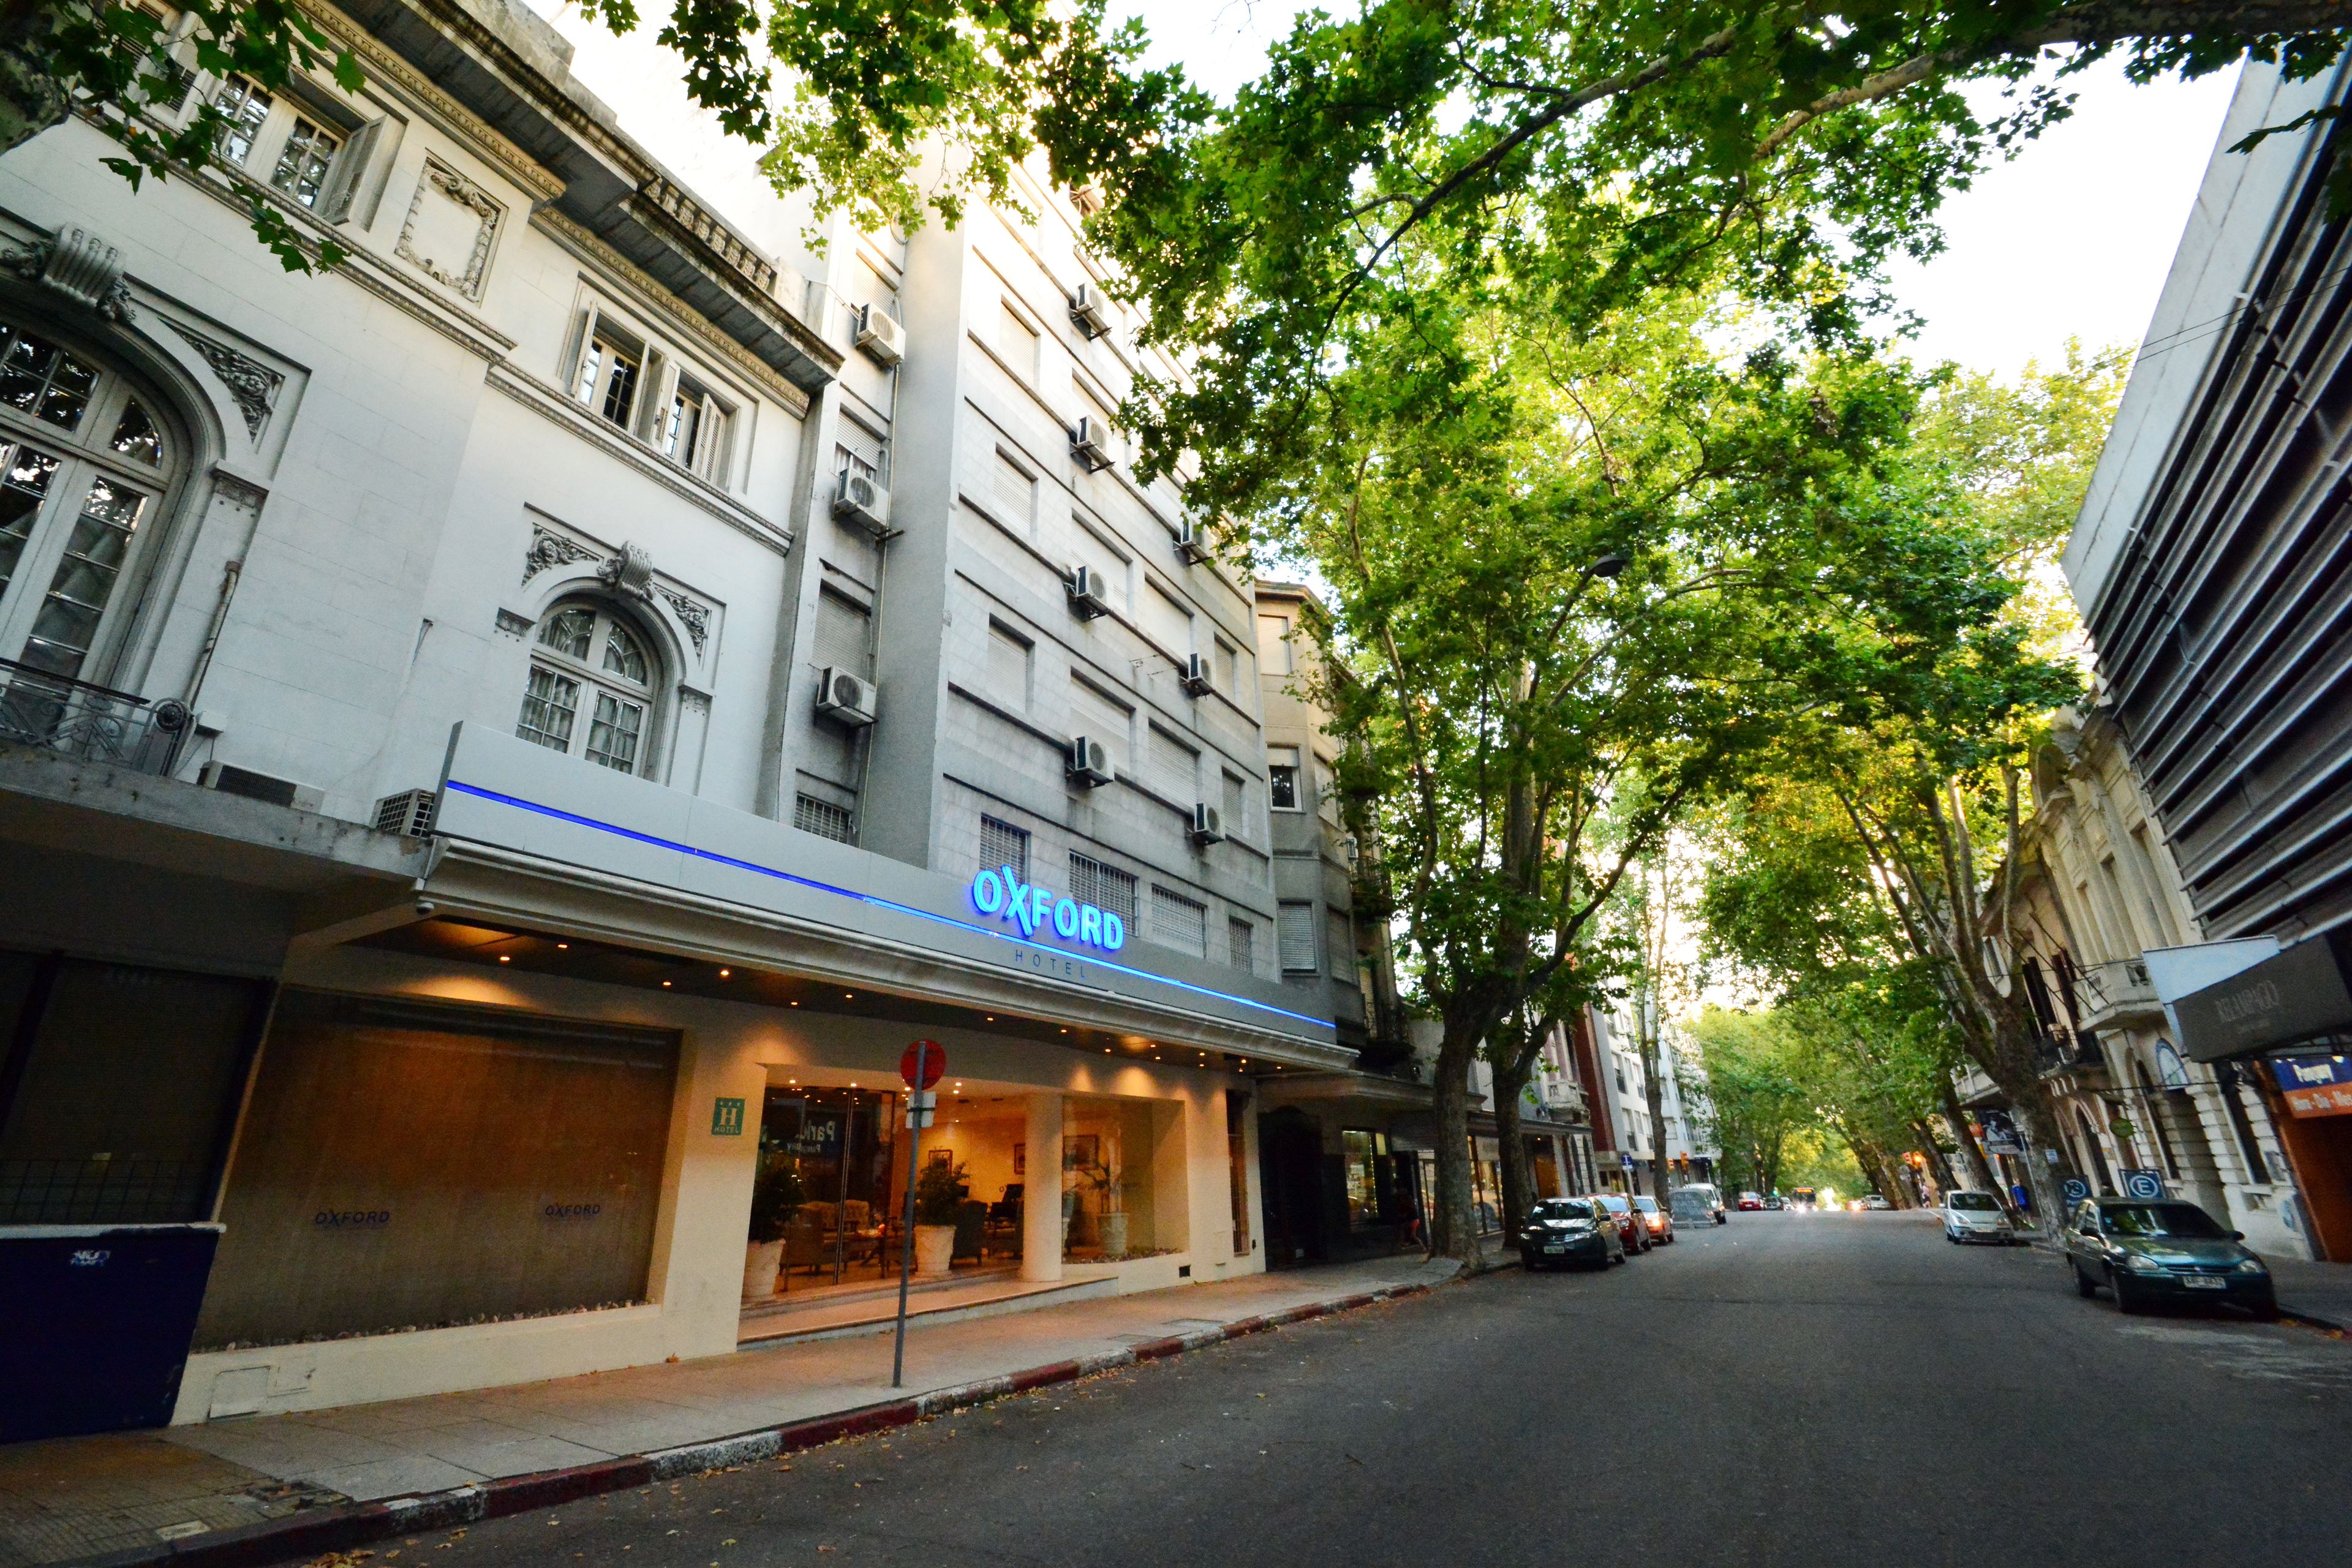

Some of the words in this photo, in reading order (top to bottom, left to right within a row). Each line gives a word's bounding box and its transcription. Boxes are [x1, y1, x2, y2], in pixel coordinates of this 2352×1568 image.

[973, 864, 1124, 950] OXFORD
[1015, 949, 1086, 979] HOTEL
[2136, 1179, 2152, 1194] E
[315, 1208, 390, 1226] OXFORD
[545, 1204, 601, 1218] OXFORD
